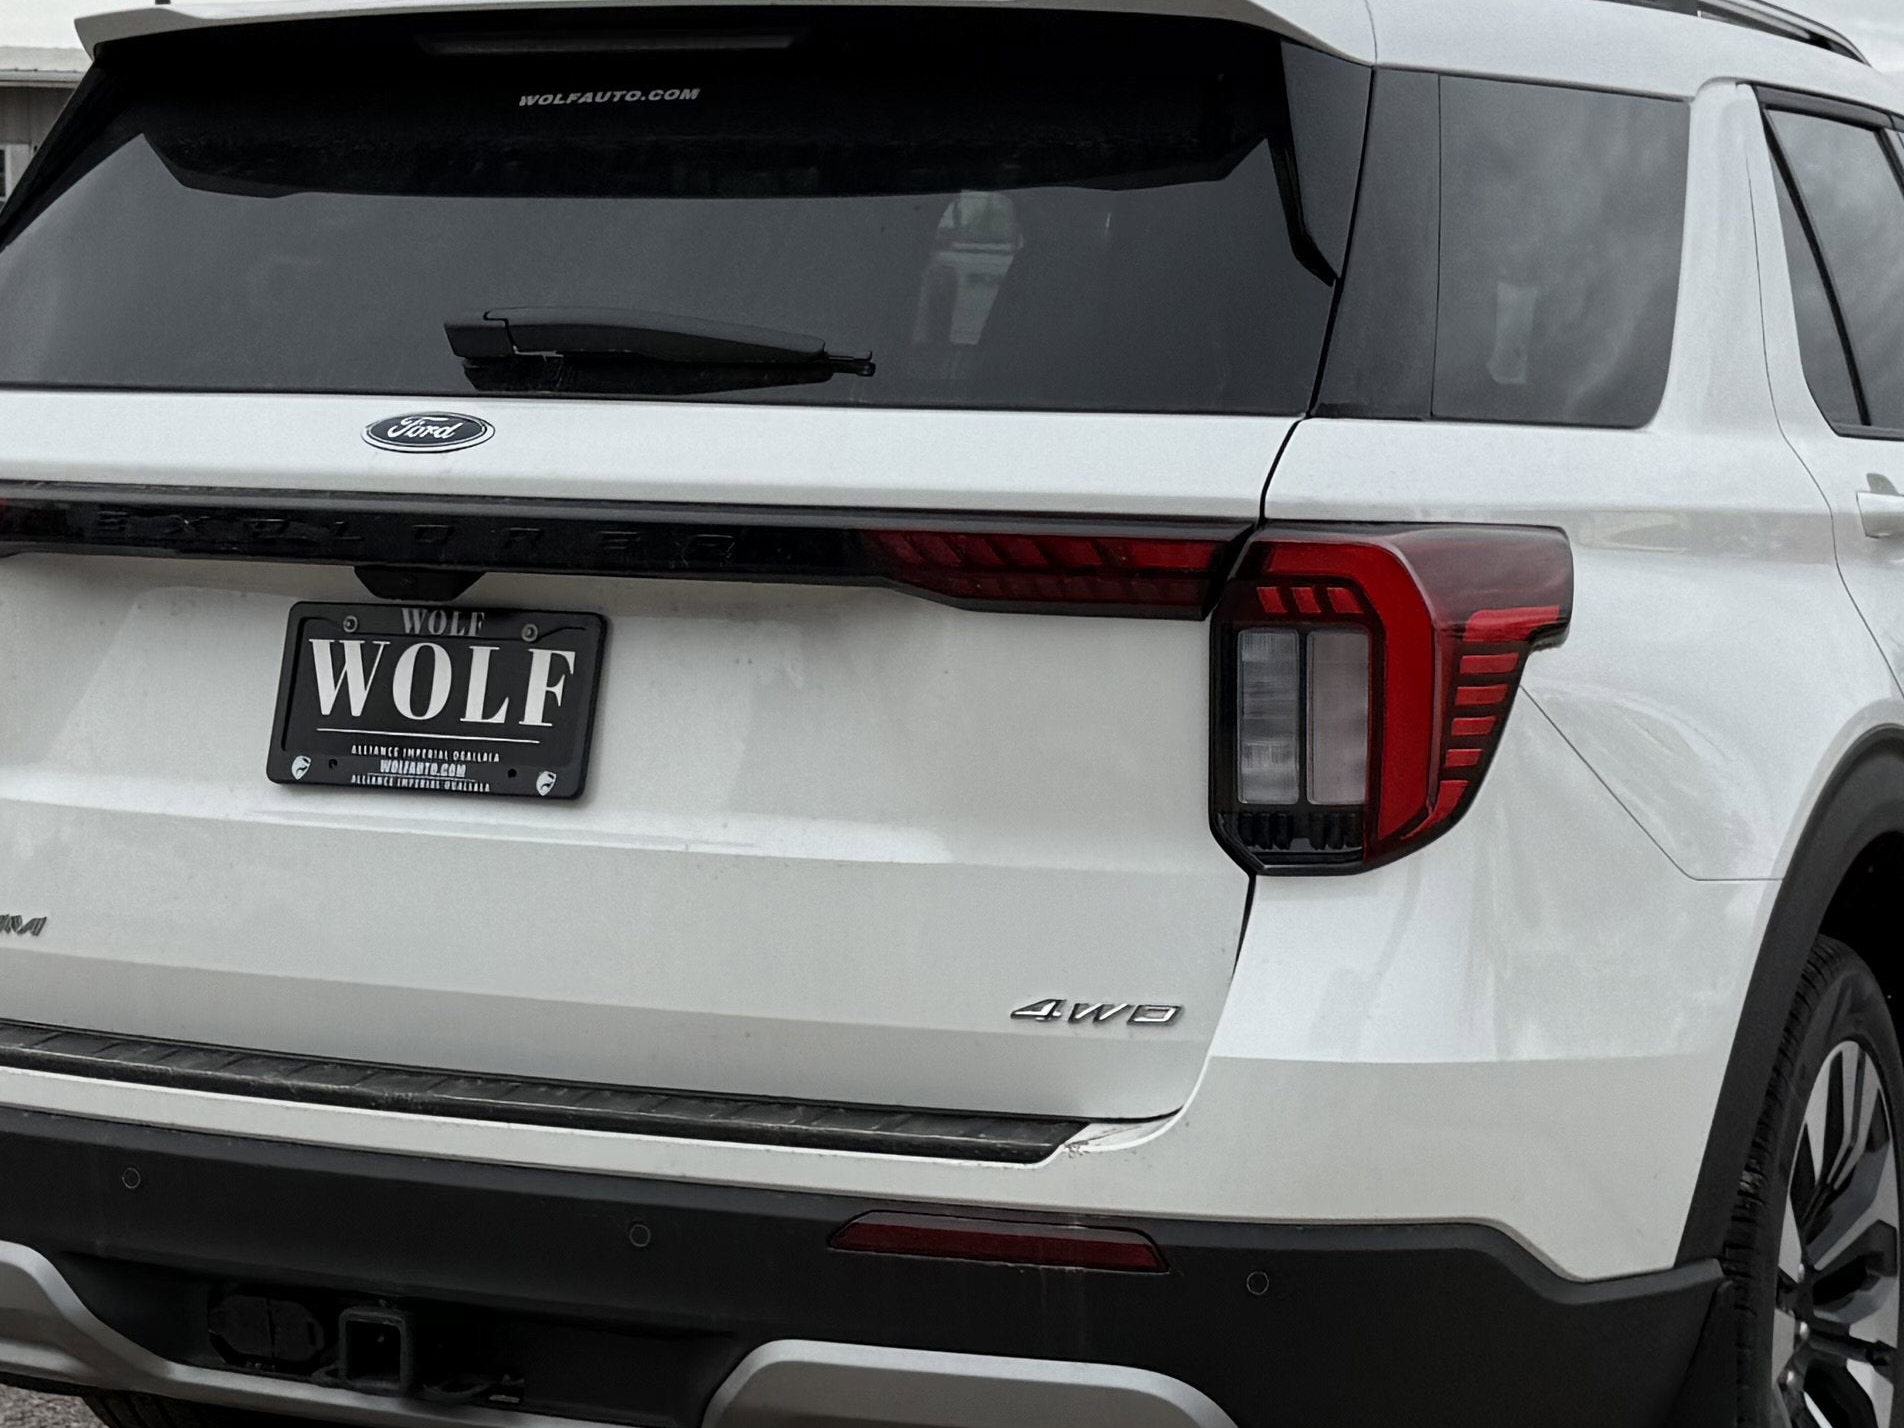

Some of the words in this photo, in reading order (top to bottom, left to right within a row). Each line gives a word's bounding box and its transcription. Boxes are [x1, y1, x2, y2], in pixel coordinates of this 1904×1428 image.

[518, 87, 701, 107] WOLFAUTO.COM
[386, 416, 464, 439] Ford
[400, 607, 485, 636] WOLF
[308, 637, 576, 727] WOLF
[351, 744, 399, 757] ALLIANCE
[380, 759, 467, 778] WOLFAUTO.COM
[1010, 998, 1183, 1025] 4WD
